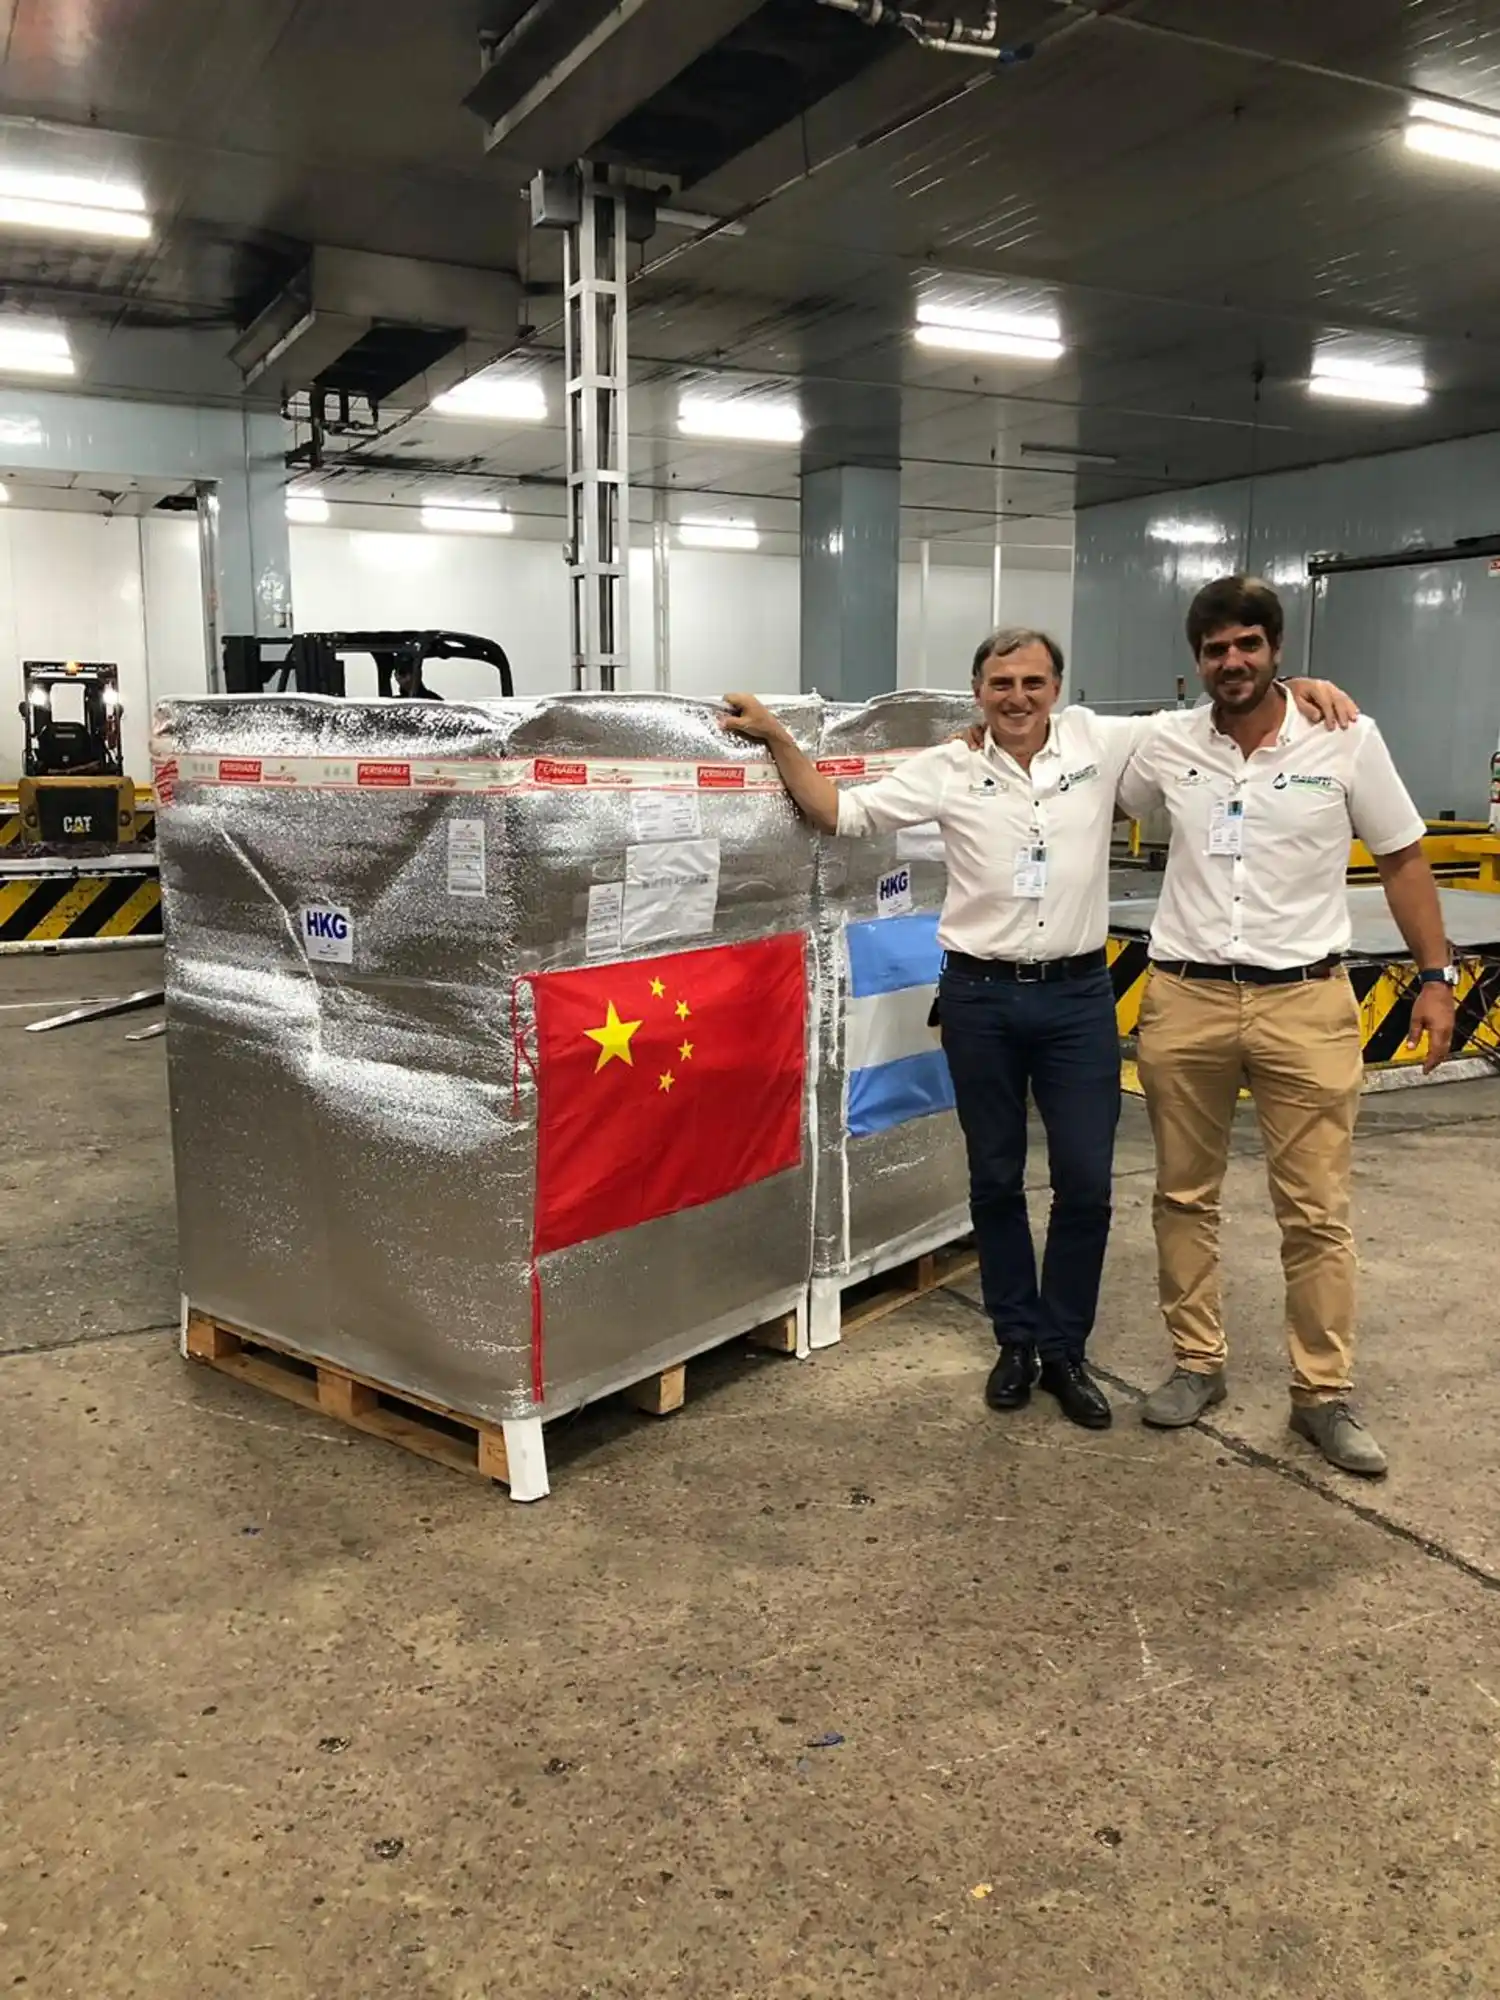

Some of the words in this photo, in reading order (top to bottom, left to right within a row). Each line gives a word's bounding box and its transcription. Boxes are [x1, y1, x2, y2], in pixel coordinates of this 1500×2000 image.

[359, 765, 408, 776] PERISHABLE
[63, 815, 93, 833] CAT
[880, 871, 908, 900] HKG
[307, 911, 347, 940] HKG
